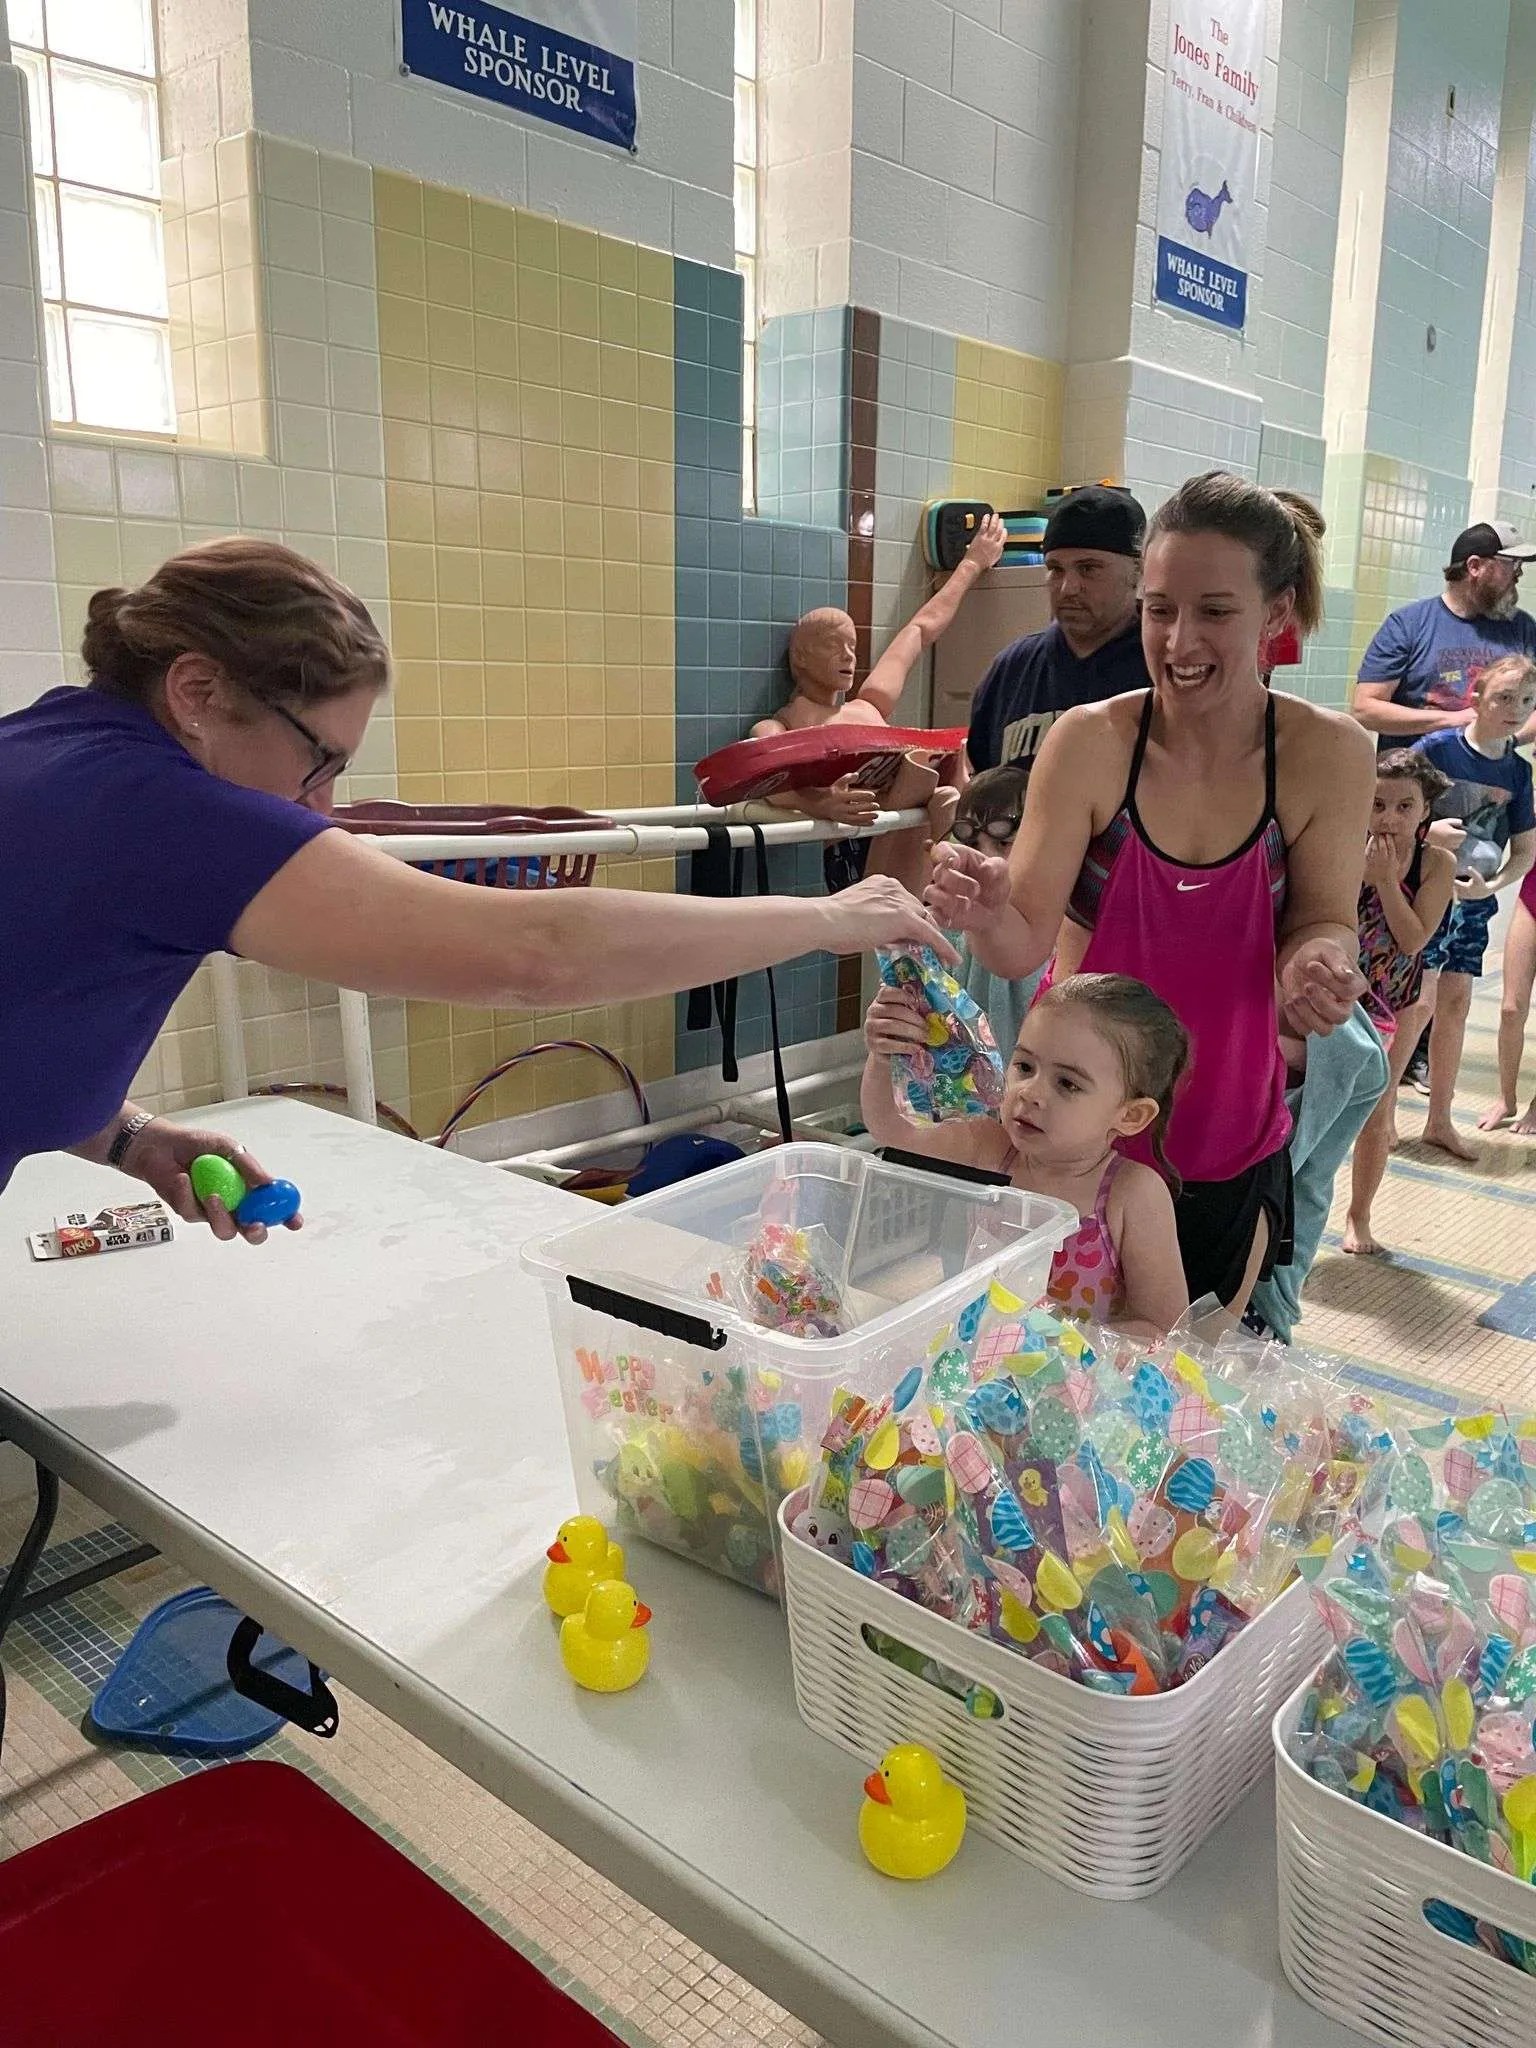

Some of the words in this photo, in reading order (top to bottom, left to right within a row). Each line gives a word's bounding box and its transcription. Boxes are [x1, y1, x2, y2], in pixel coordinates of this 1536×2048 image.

[429, 2, 528, 64] WHALE
[541, 46, 615, 96] LEVEL
[1210, 17, 1229, 46] The
[464, 46, 584, 113] SPONSOR
[1173, 23, 1210, 70] Jones
[1215, 52, 1259, 106] Family
[1196, 86, 1214, 109] Fran
[1167, 252, 1205, 284] WHALE
[1209, 271, 1238, 298] LEVEL
[1177, 277, 1225, 312] SPONSOR
